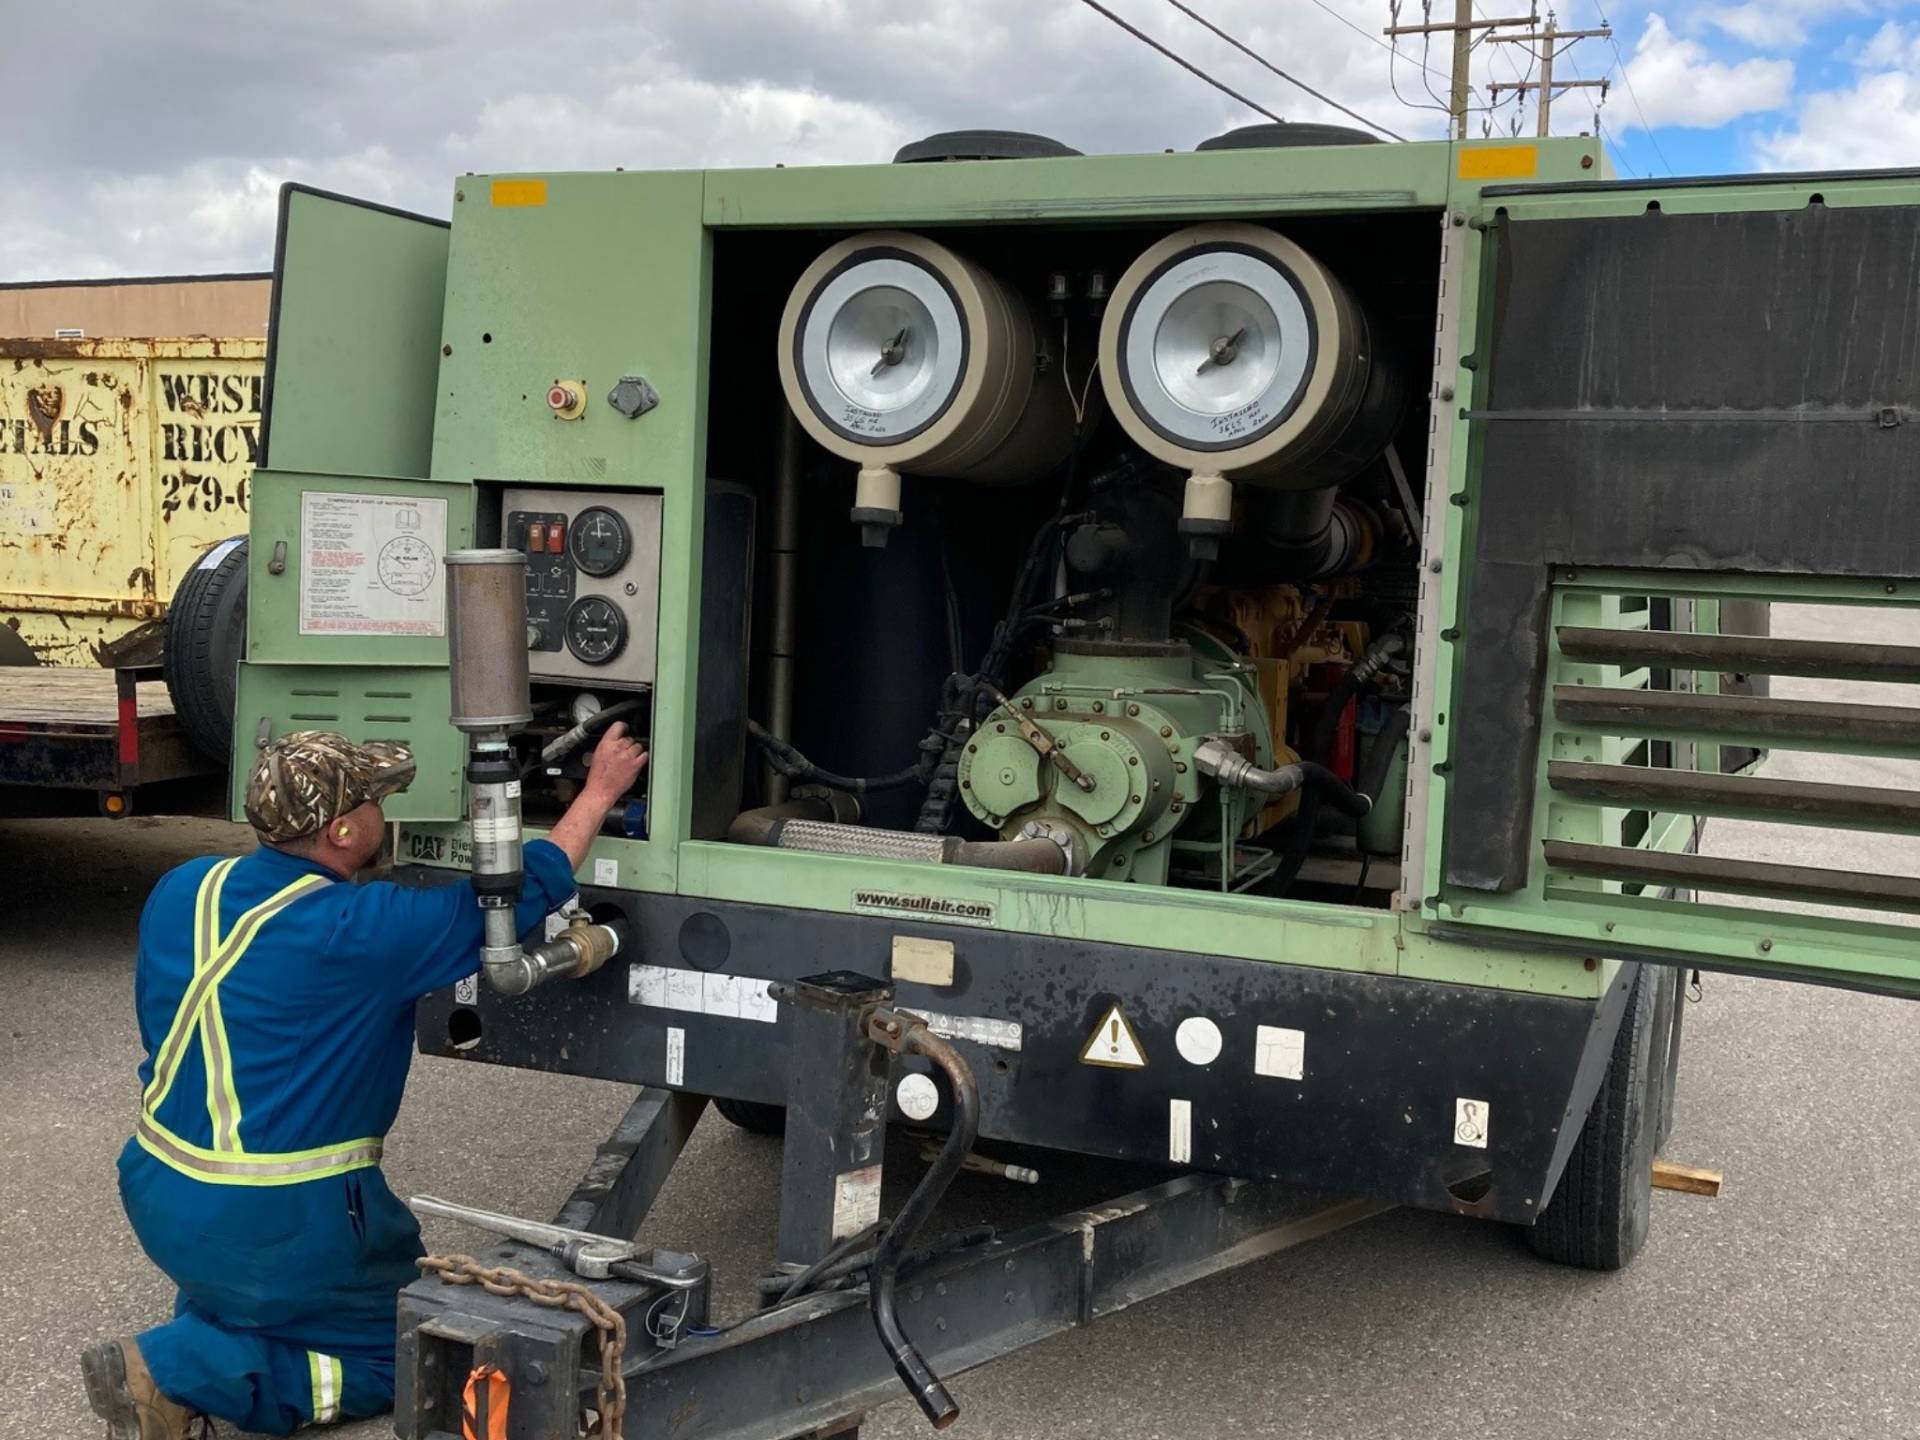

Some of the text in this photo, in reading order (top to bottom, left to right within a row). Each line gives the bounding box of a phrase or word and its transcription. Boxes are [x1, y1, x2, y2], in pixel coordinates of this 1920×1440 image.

[160, 374, 263, 413] WEST
[160, 424, 261, 463] RECY
[411, 834, 446, 861] CAT
[857, 893, 991, 917] www.sullair.com
